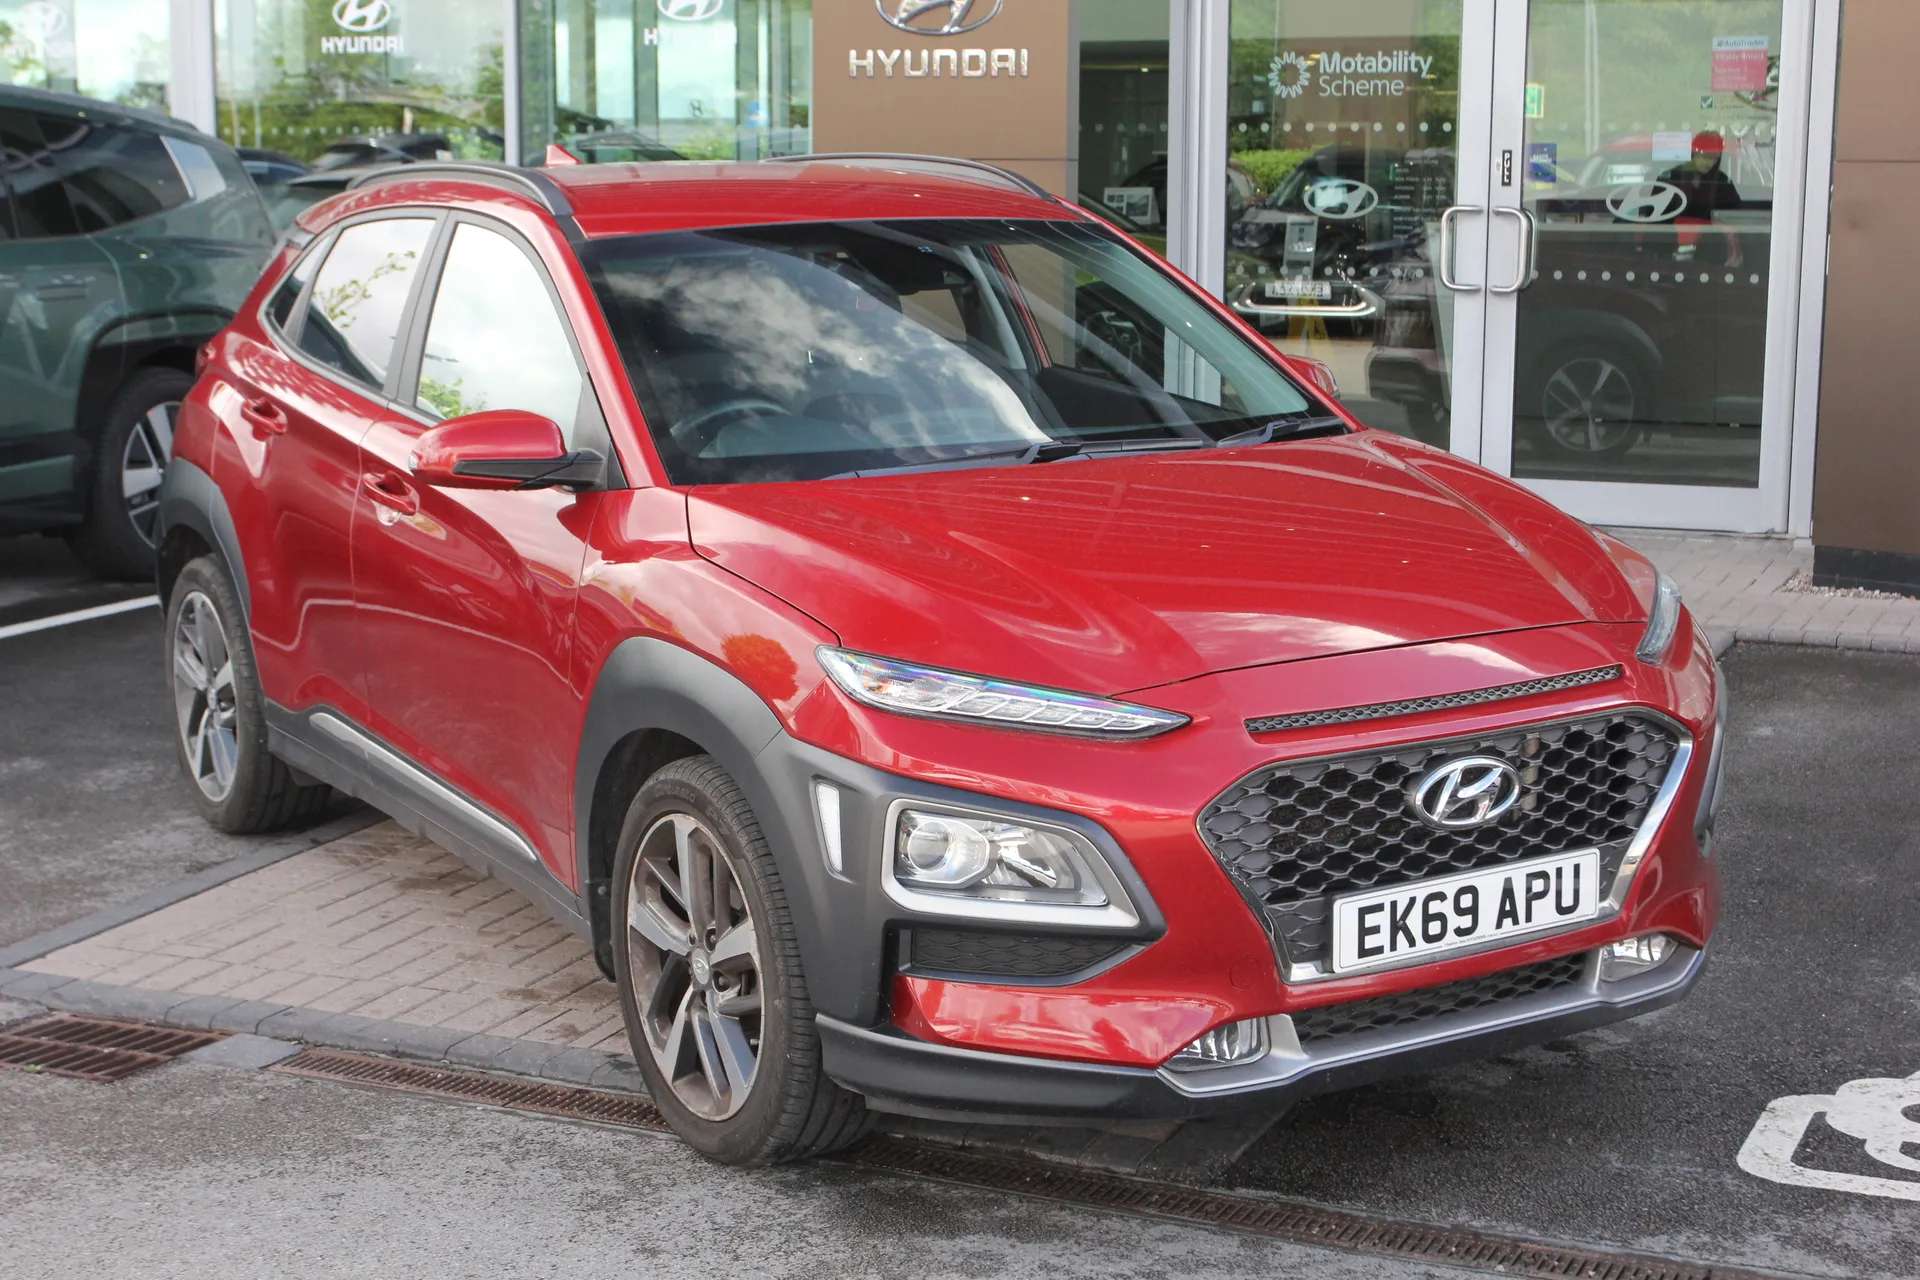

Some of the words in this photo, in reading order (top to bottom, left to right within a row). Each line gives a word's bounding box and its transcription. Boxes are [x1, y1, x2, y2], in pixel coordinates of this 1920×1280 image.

[320, 36, 404, 55] HYUNDAI
[849, 48, 1029, 77] HYUNDAI
[1319, 51, 1433, 79] Motability
[1319, 75, 1405, 97] Scheme
[1503, 152, 1511, 183] PULL
[1357, 885, 1479, 959] EK69
[1495, 863, 1581, 930] APU
